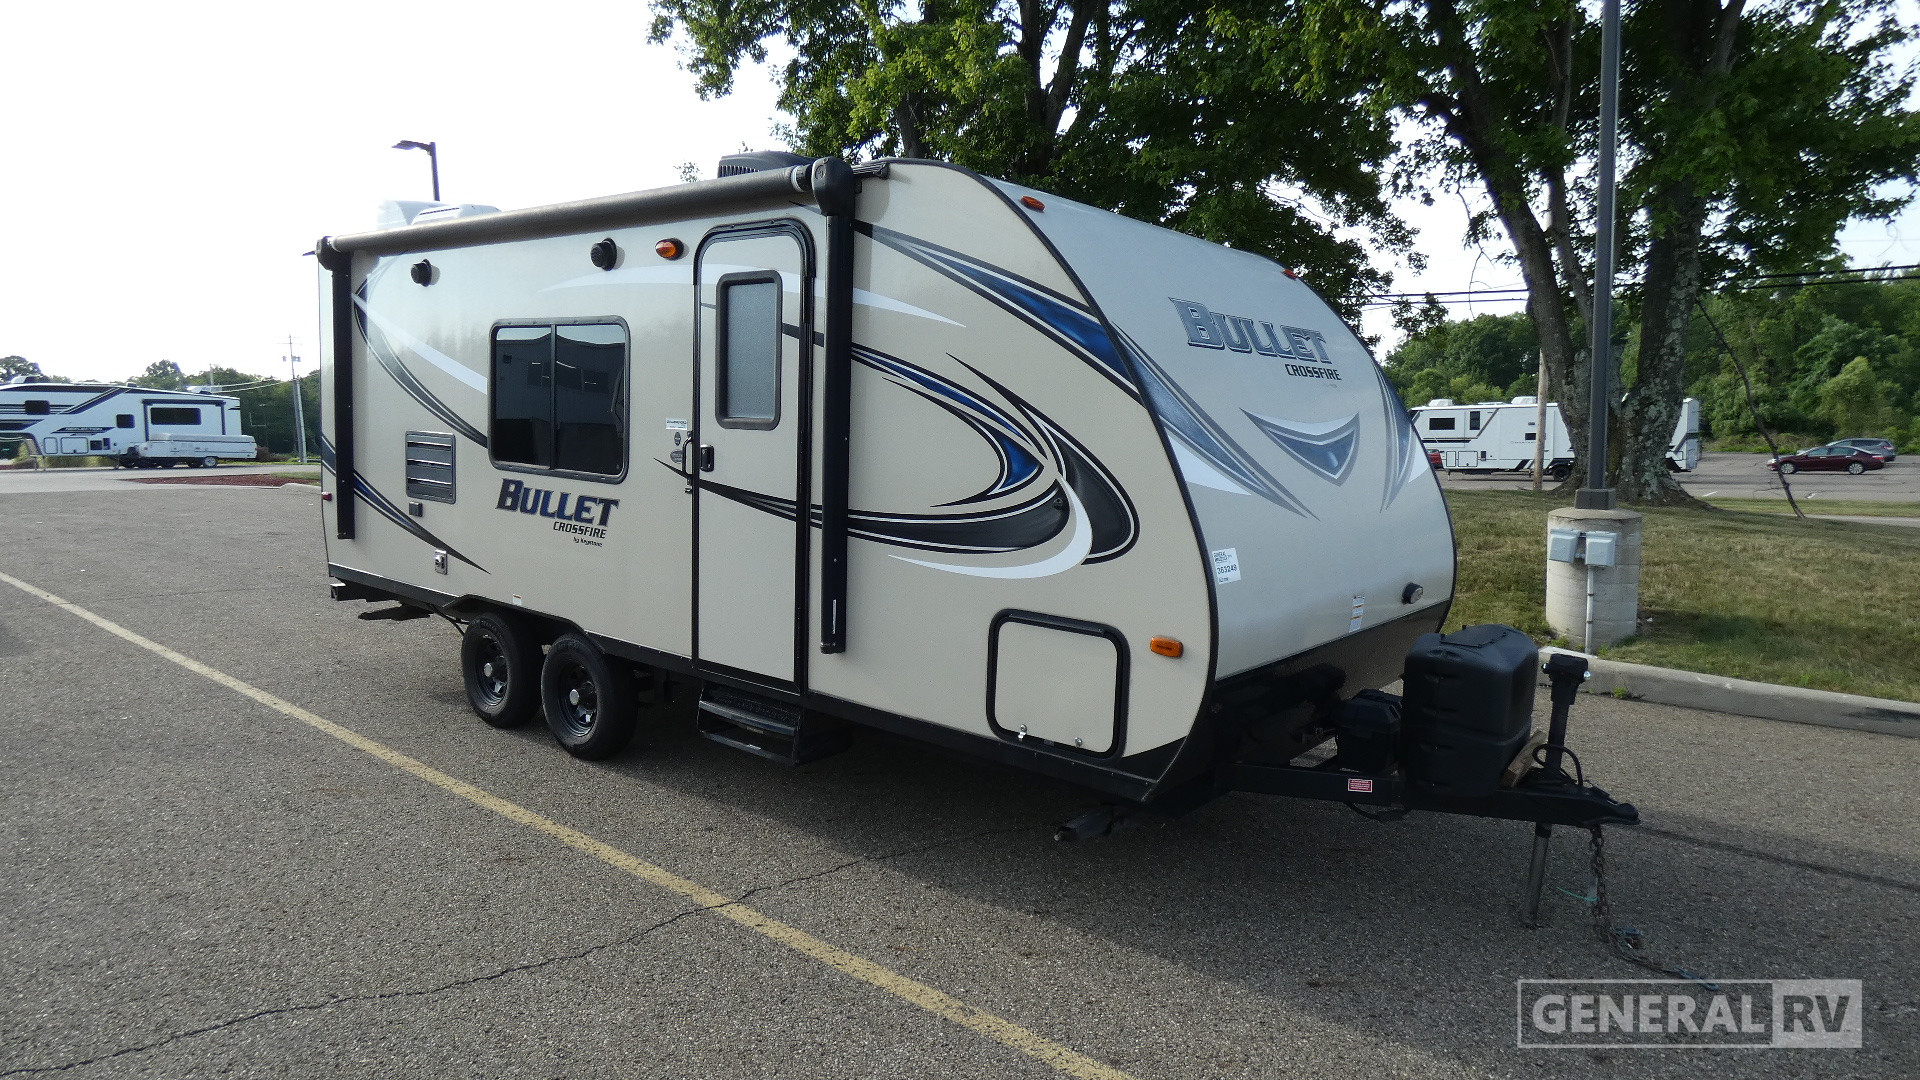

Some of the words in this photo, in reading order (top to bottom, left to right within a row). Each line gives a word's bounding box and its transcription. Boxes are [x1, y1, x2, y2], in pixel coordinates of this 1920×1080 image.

[1167, 297, 1333, 364] BULLET
[1285, 363, 1342, 381] CROSSFIRE
[495, 478, 620, 527] BULLET
[553, 521, 607, 539] CROSSFIRE
